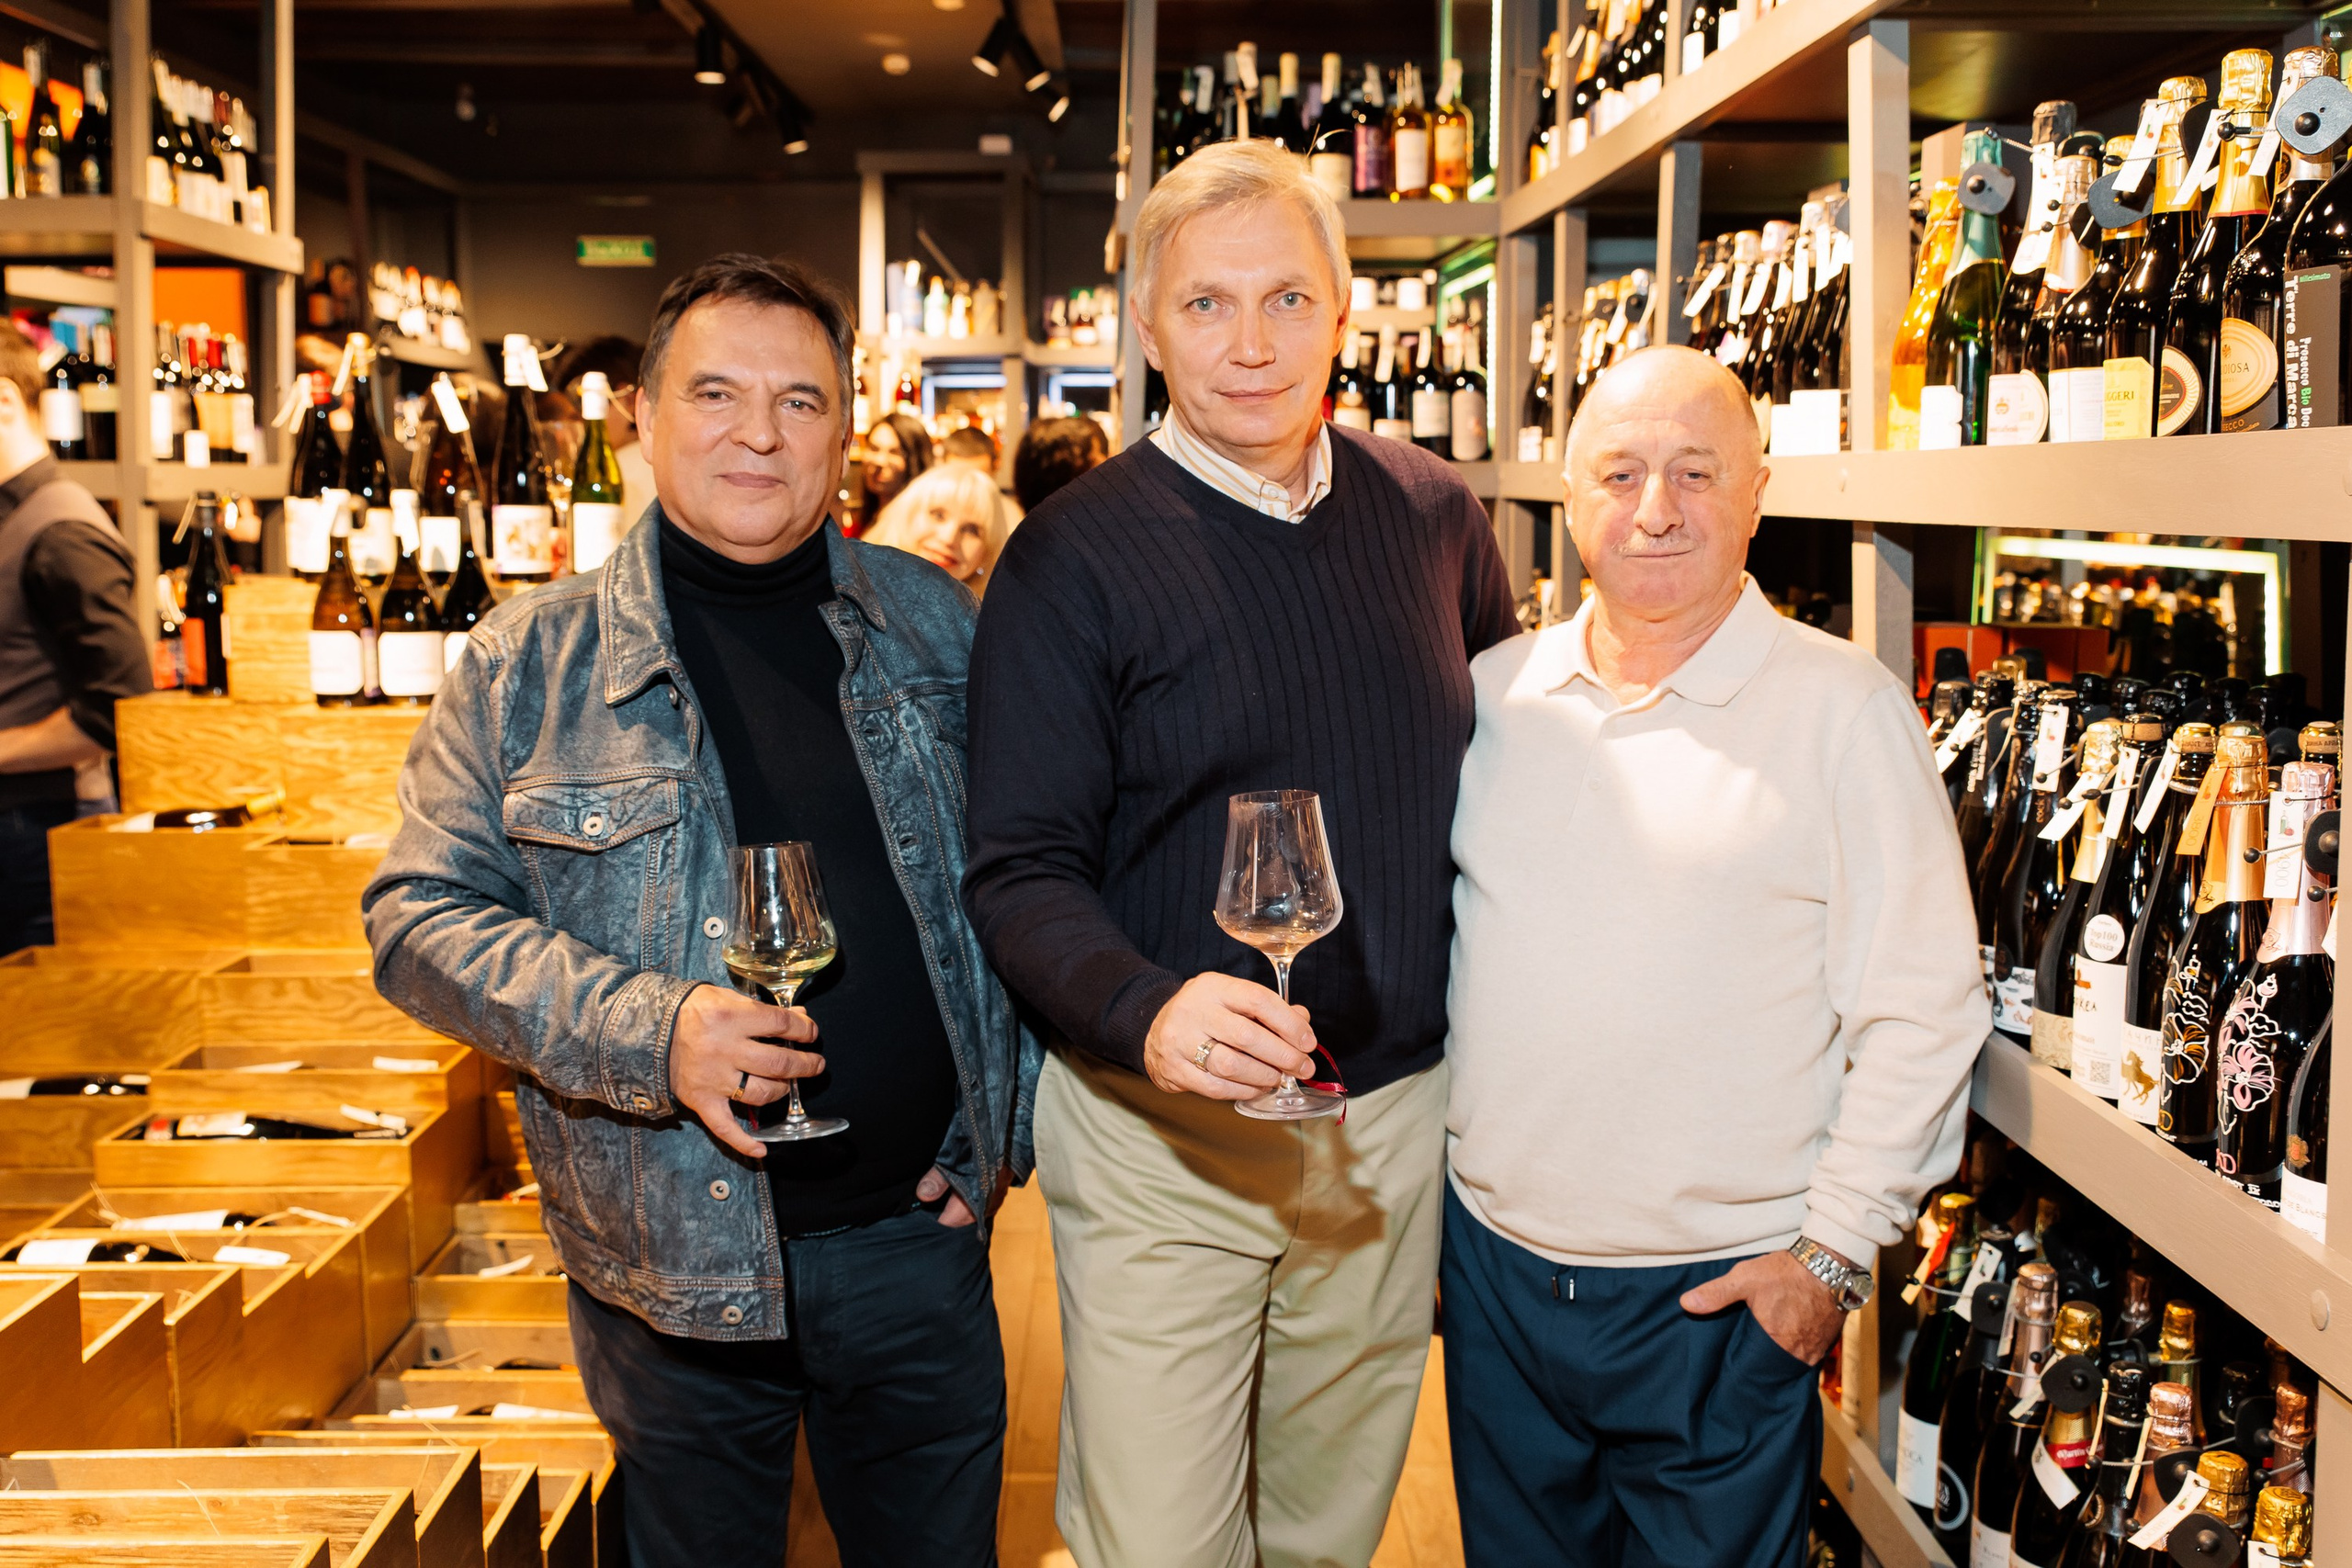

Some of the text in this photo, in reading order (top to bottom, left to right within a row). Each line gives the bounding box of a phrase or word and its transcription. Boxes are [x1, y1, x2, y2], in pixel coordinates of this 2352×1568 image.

[2284, 275, 2300, 429] Terre di Marca
[2299, 336, 2312, 387] Prosecco
[2301, 387, 2312, 406] Bio
[2186, 813, 2205, 847] 3800
